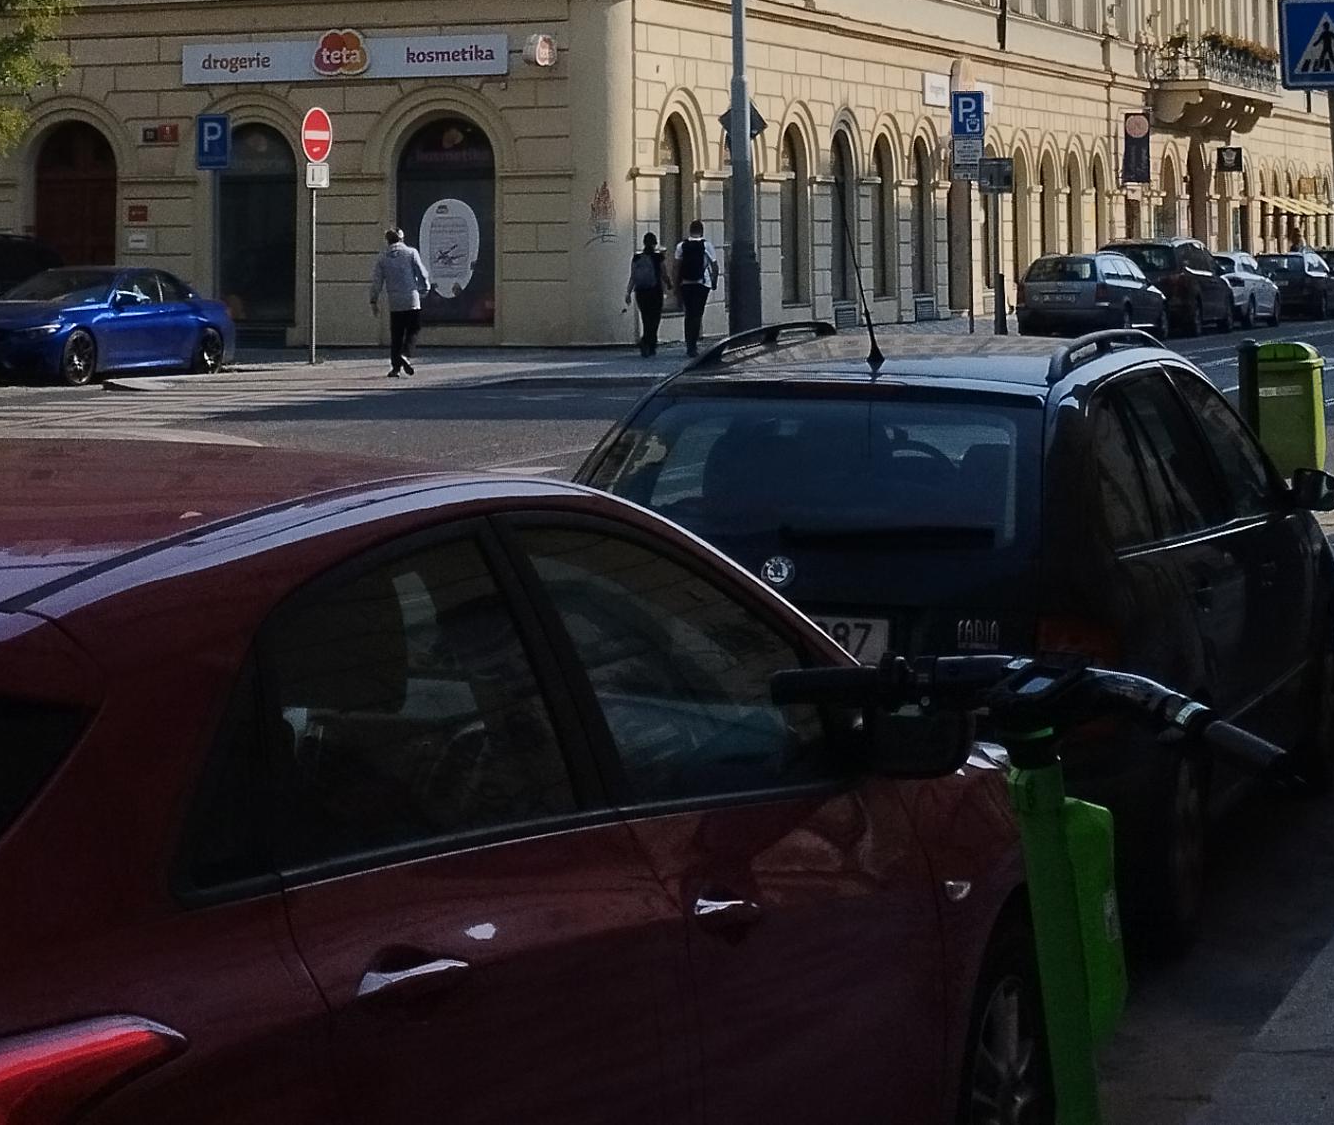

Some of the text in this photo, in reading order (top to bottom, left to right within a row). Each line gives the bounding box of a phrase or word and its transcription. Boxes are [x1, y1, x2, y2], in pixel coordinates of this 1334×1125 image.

[201, 45, 495, 73] drogerie teta kosmetika
[958, 97, 976, 123] P
[203, 122, 222, 153] P
[816, 620, 873, 659] 87
[957, 619, 1000, 643] FABIA
